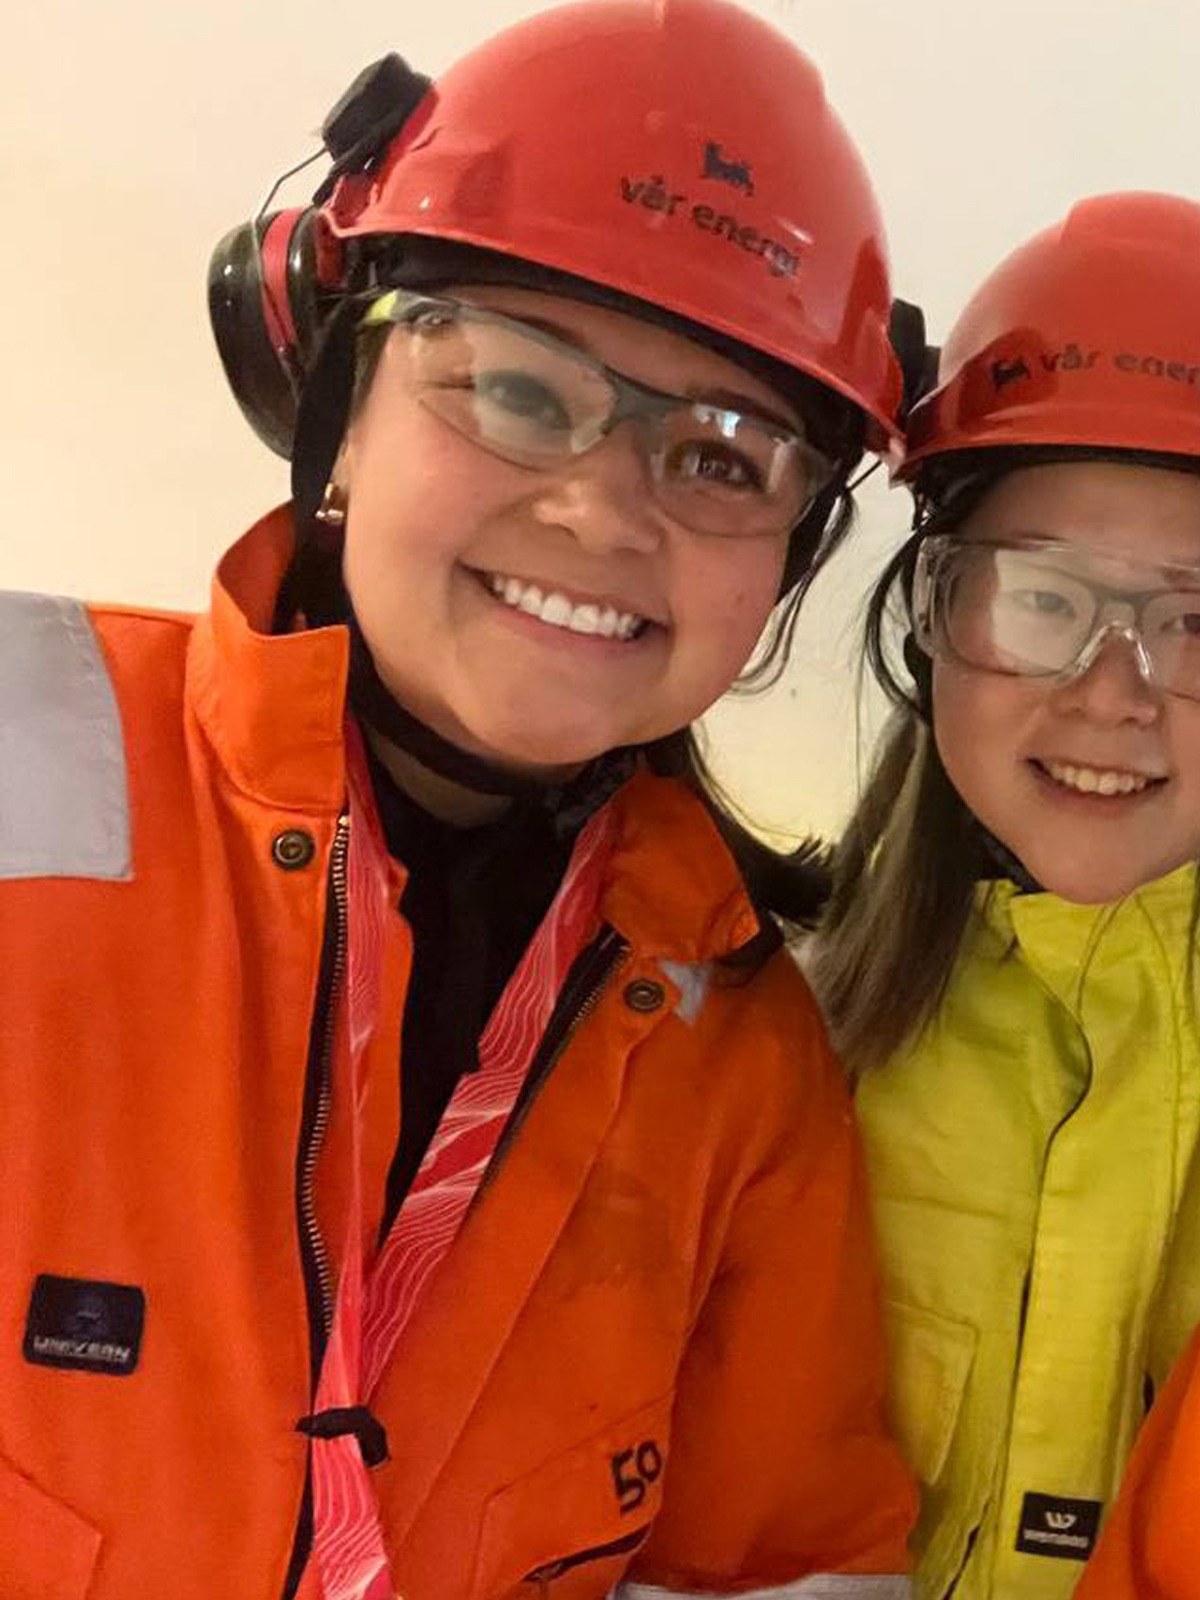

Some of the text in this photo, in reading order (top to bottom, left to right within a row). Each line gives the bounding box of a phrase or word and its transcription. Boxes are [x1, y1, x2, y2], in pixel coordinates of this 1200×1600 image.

[620, 175, 800, 278] vår energi
[1040, 343, 1099, 372] vår
[611, 1440, 662, 1516] 50
